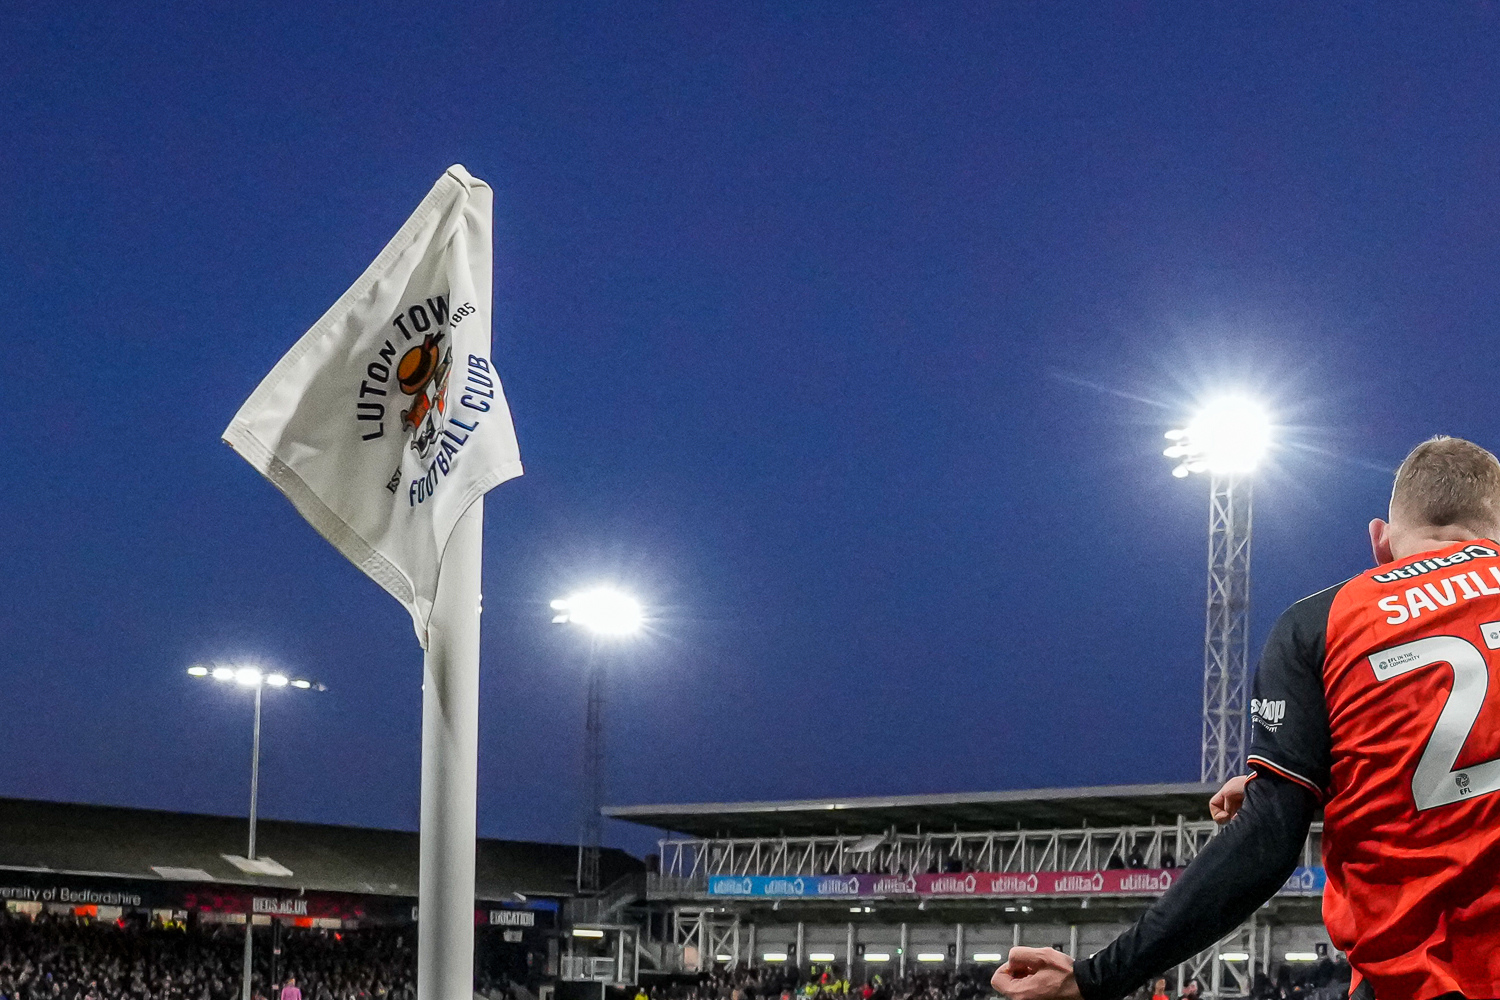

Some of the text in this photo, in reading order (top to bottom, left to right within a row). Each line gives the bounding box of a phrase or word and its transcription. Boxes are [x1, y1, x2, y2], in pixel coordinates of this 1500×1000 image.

[449, 302, 476, 329] 1885
[357, 289, 451, 441] LUTON TOW
[409, 354, 494, 507] FOOTBALL CLUB
[1373, 551, 1471, 583] utilita
[1459, 787, 1472, 796] EFL
[931, 877, 966, 893] utilita
[991, 877, 1026, 892] utilita
[1055, 876, 1092, 892] utilita
[1120, 874, 1158, 891] utilita
[43, 887, 56, 901] of
[60, 887, 141, 906] Bedfordshire
